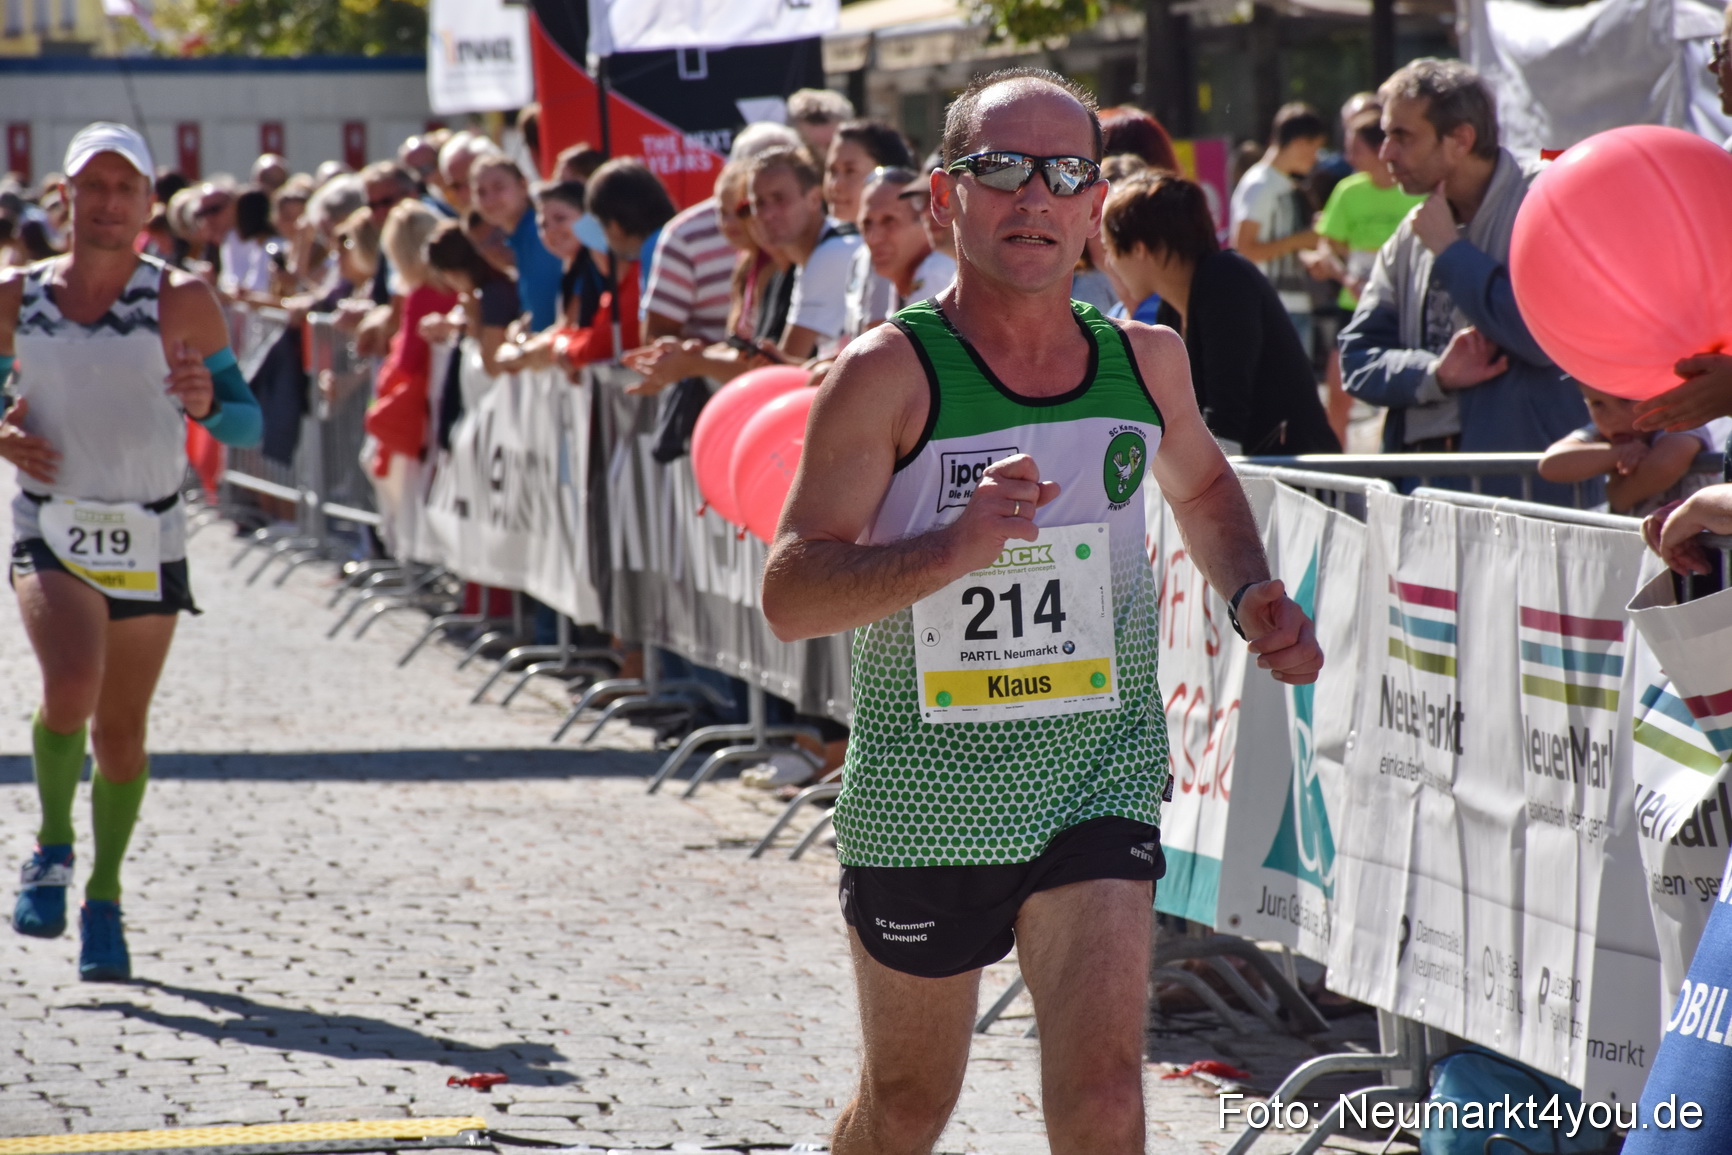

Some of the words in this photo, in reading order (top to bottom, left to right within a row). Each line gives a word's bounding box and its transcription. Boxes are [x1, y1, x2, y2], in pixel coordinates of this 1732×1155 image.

[642, 134, 677, 152] THE
[683, 128, 732, 151] NEXT
[948, 490, 961, 499] Die
[68, 526, 131, 555] 219
[988, 544, 1056, 569] OCK
[1007, 566, 1027, 575] smart
[1028, 564, 1056, 574] concepts
[961, 579, 1067, 641] 214
[926, 632, 935, 642] A
[960, 651, 1001, 662] PARTL
[1004, 645, 1058, 660] Neumarkt
[988, 675, 1052, 698] Klaus
[875, 917, 887, 928] SC
[889, 920, 935, 930] Kemmern
[882, 932, 928, 942] RUNNING
